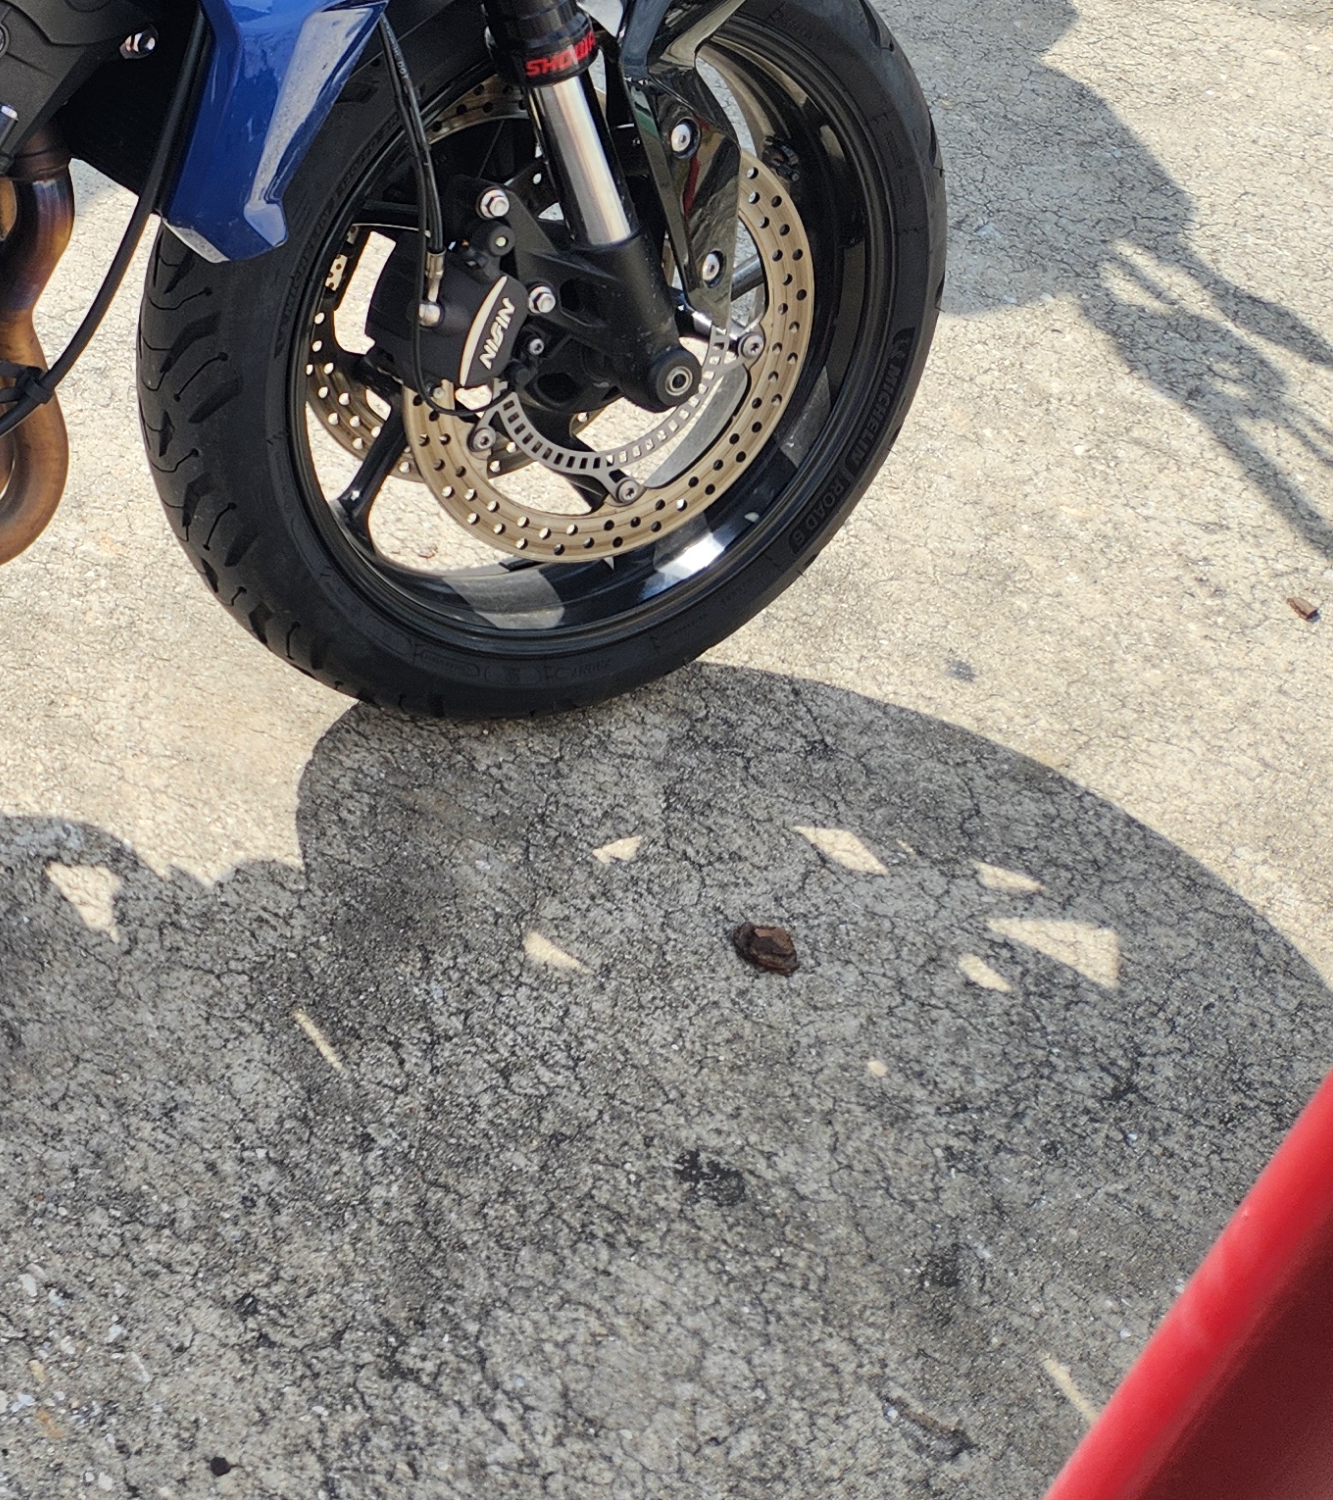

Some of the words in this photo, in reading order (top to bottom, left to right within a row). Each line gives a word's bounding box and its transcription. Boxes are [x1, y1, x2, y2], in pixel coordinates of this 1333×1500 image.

[479, 297, 515, 370] NISSIN
[852, 362, 903, 464] MICHELIN
[805, 478, 844, 533] ROAD
